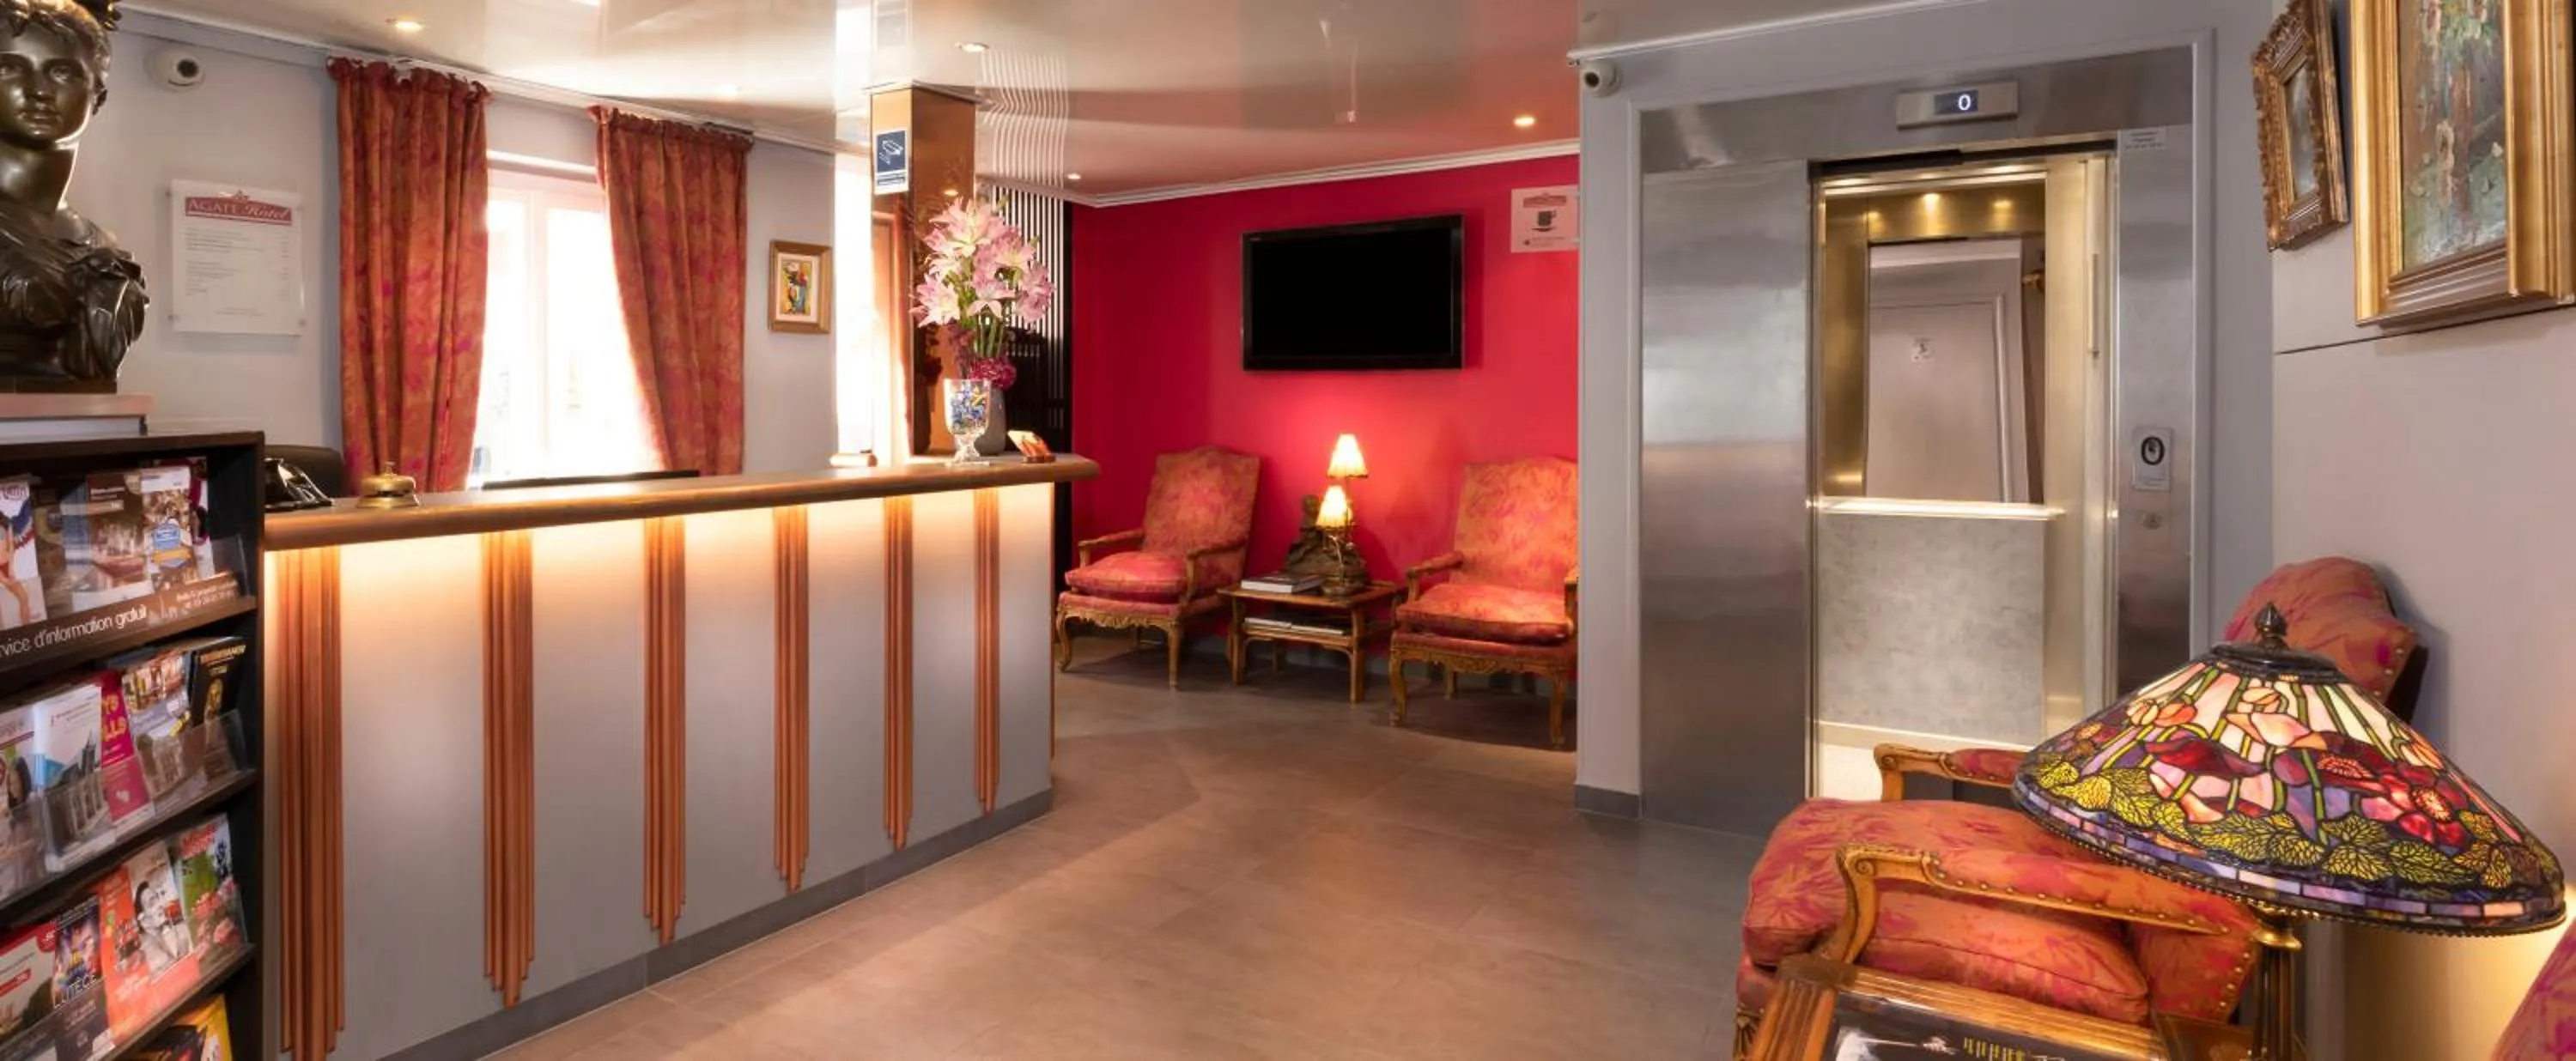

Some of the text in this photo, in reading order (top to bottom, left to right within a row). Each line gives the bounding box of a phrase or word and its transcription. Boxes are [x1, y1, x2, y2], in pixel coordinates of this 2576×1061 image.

[1958, 94, 1971, 111] 0
[188, 198, 239, 215] AGATE
[34, 615, 113, 650] d'information
[116, 604, 148, 629] gratuit
